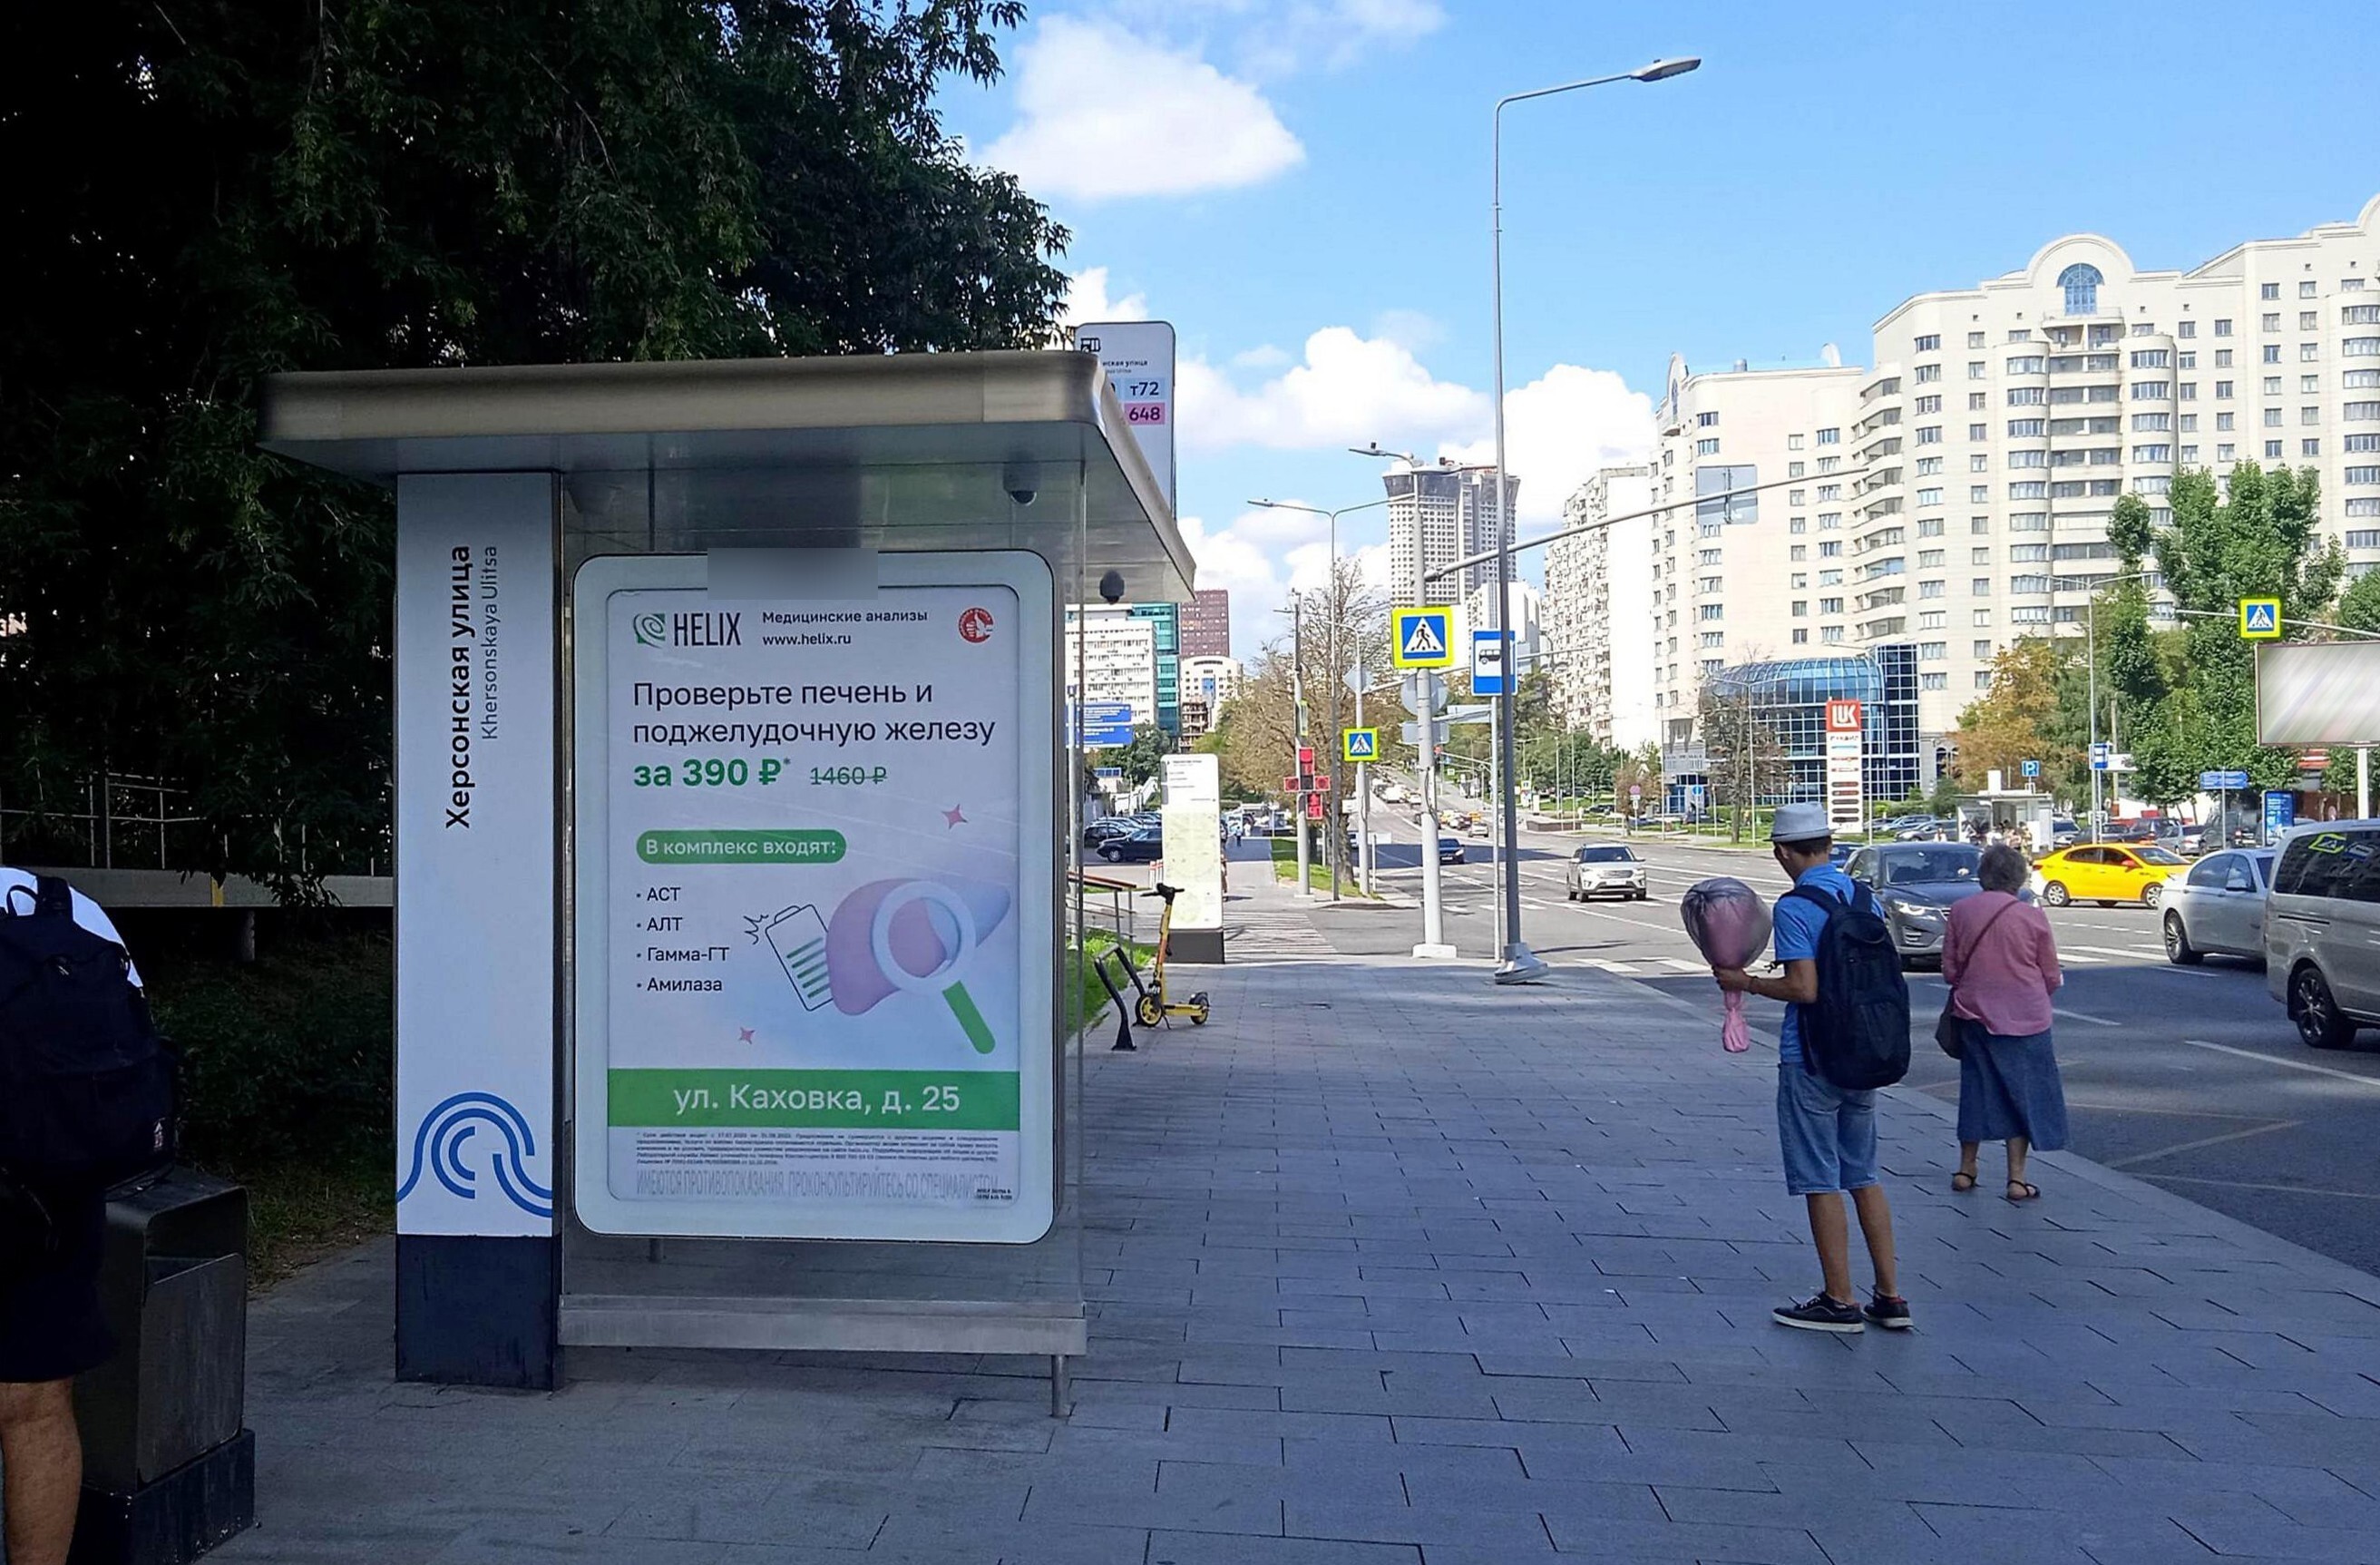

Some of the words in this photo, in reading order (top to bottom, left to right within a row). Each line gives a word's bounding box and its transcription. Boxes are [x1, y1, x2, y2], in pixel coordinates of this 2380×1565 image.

[1129, 382, 1159, 396] т72
[1129, 406, 1160, 421] 648
[481, 546, 497, 599] Ulitsa
[452, 546, 475, 638] улица
[674, 612, 741, 646] HELIX
[763, 611, 861, 625] Медицинские
[865, 611, 928, 621] анализы
[762, 633, 852, 645] www.helix.ru
[481, 603, 501, 739] Khersonskaya
[634, 682, 792, 710] Проверьте
[802, 684, 906, 704] печень
[916, 684, 932, 703] и
[446, 646, 475, 828] Херсонская
[634, 721, 876, 748] поджелудочную
[885, 720, 995, 746] железу
[634, 765, 671, 787] за
[682, 758, 748, 787] 390
[810, 767, 865, 785] 1460
[646, 839, 658, 854] В
[664, 840, 757, 855] комплекс
[763, 840, 835, 856] входят:
[647, 887, 681, 901] АСТ
[647, 917, 682, 931] АЛТ
[648, 947, 729, 961] Гамма-ГТ
[647, 978, 722, 991] Амилаза
[674, 1089, 718, 1115] ул.
[730, 1084, 871, 1115] Каховка,
[882, 1091, 912, 1114] д.
[922, 1086, 960, 1111] 25
[637, 1170, 682, 1195] ИМЕЮТСЯ
